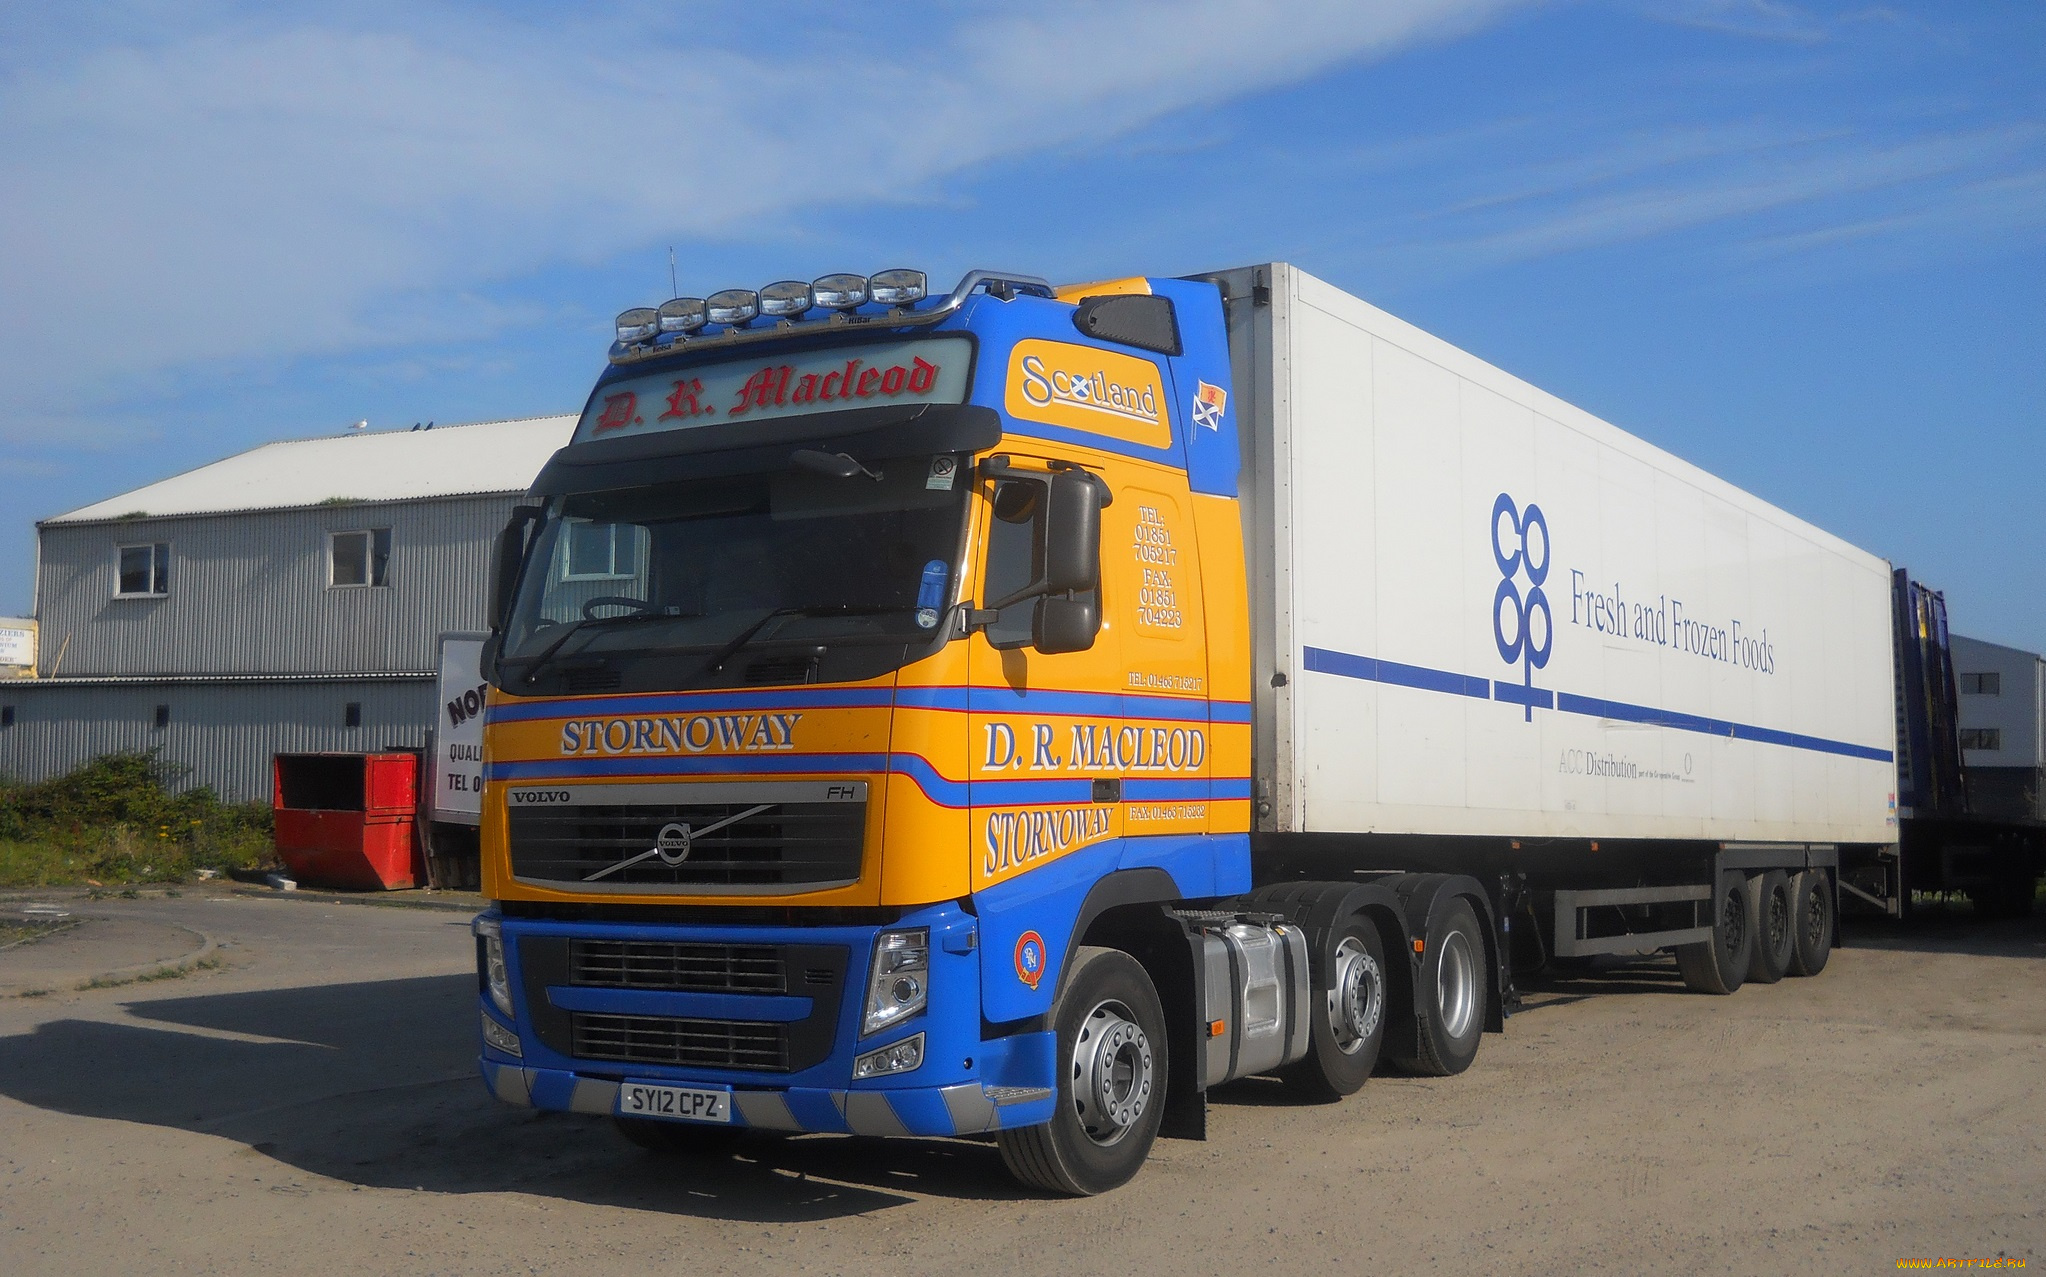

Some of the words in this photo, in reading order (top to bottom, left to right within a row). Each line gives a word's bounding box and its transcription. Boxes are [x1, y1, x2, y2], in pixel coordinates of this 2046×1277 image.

[593, 390, 643, 433] D.
[658, 379, 713, 422] R.
[728, 355, 940, 417] Macleod
[1021, 356, 1158, 417] Scotland
[1138, 506, 1165, 526] TEL:
[1134, 524, 1171, 546] 01851
[1132, 544, 1177, 566] 705217
[1143, 568, 1172, 589] FAX:
[1139, 588, 1176, 608] 01851
[1136, 607, 1182, 628] 704223
[1569, 568, 1628, 638] Fresh
[1634, 595, 1667, 646] and
[1671, 599, 1728, 662] Frozen
[1731, 619, 1775, 675] Foods
[560, 713, 803, 755] STORNOWAY
[981, 722, 1022, 771] D.
[1029, 723, 1062, 771] R.
[1067, 724, 1205, 771] MACLEOD
[1558, 749, 1583, 774] ACC
[1586, 751, 1637, 779] Distribution
[448, 773, 468, 791] TEL
[827, 786, 855, 799] FH
[513, 791, 570, 803] VOLVO
[984, 807, 1113, 878] STORNOWAY
[632, 1088, 674, 1113] SY12
[680, 1092, 717, 1117] CPZ
